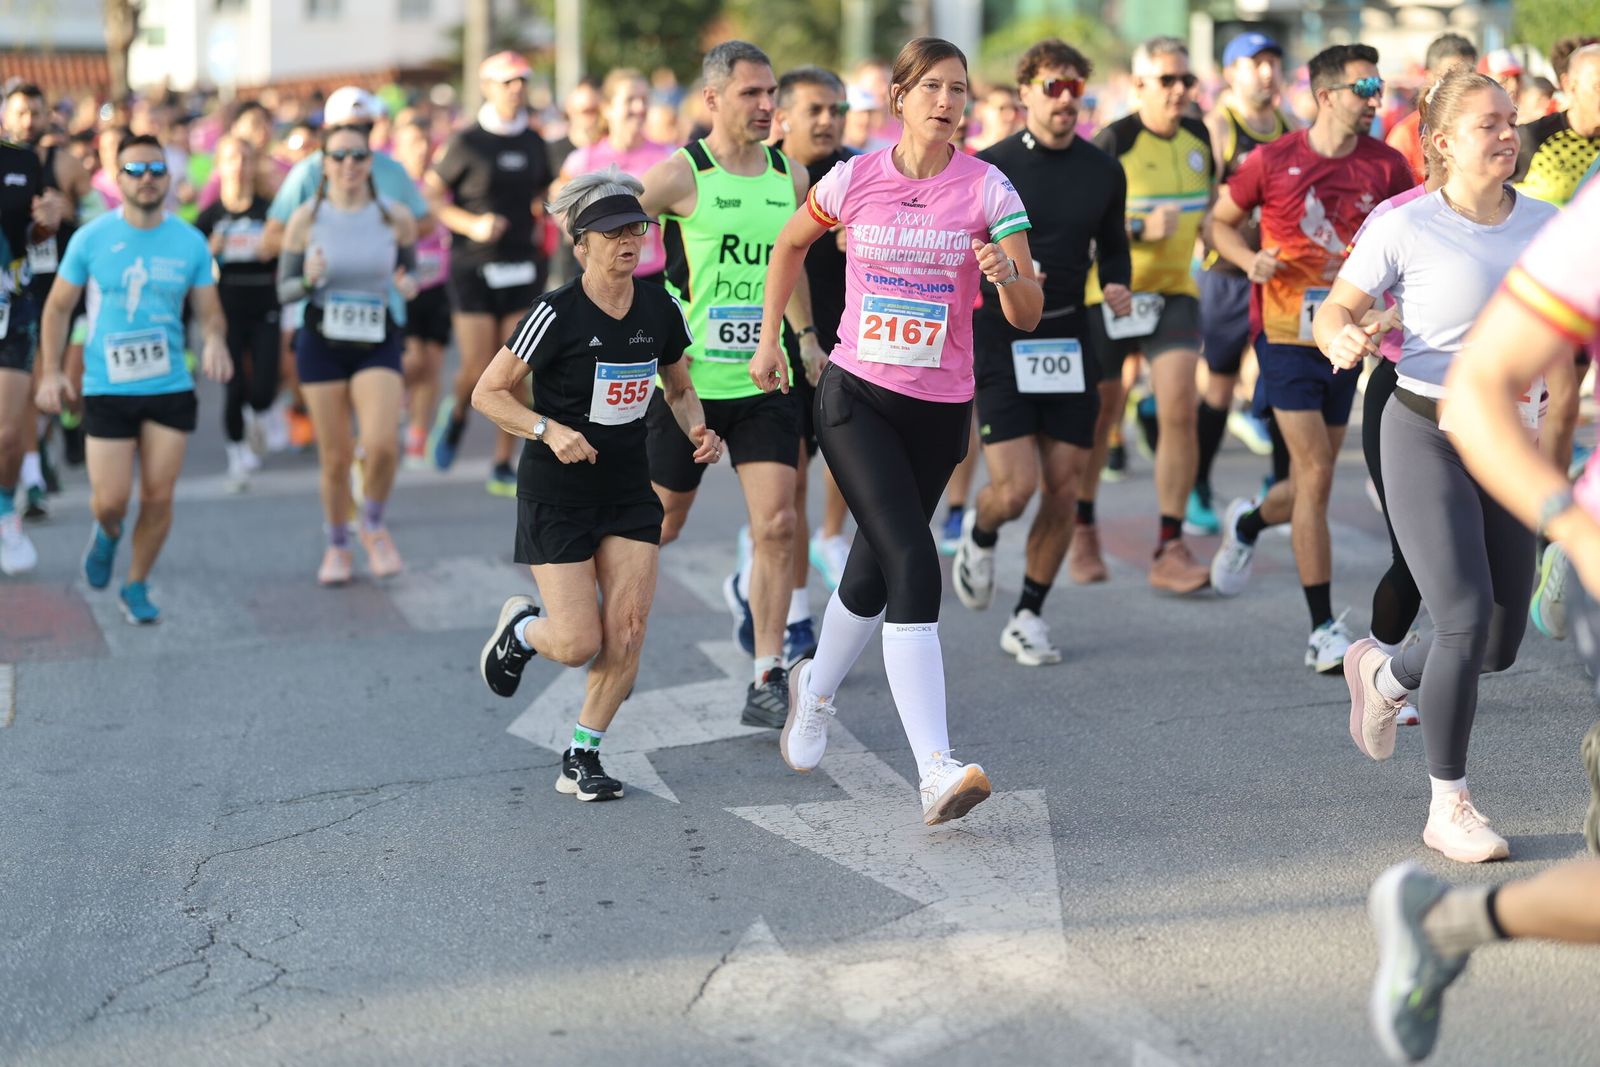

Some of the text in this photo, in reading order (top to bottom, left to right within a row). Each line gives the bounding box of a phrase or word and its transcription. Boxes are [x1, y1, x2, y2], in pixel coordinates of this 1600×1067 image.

[893, 211, 934, 226] XXXVI
[852, 224, 971, 250] MEDIA MARATÓN
[856, 243, 966, 267] INTERNACIONAL 2026
[629, 330, 654, 345] parkrun
[719, 322, 762, 344] 635
[863, 314, 942, 346] 2167
[1027, 356, 1071, 375] 700
[606, 379, 650, 406] 555
